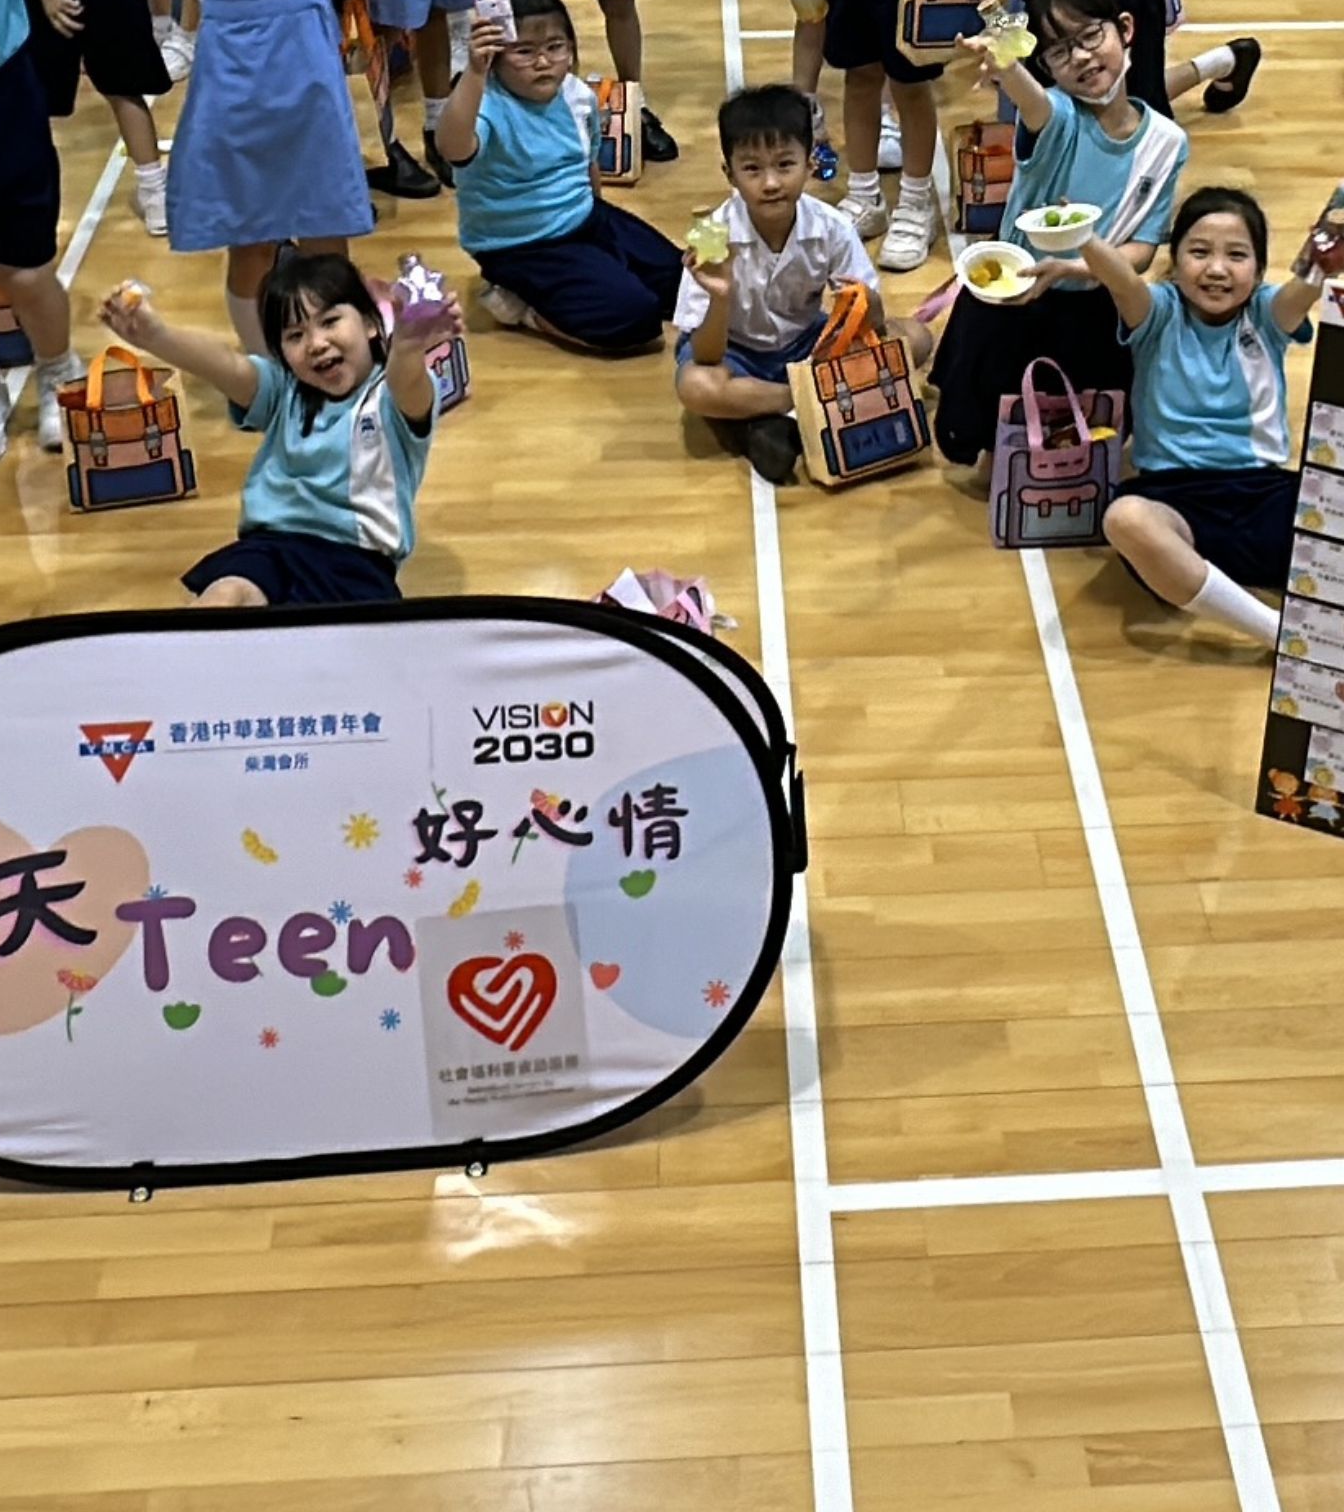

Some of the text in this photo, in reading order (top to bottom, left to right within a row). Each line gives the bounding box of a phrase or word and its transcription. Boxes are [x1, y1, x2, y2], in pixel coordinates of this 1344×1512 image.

[168, 711, 384, 745] 香港中華基督教青年會
[472, 700, 595, 732] VISION
[87, 742, 150, 755] YMCA
[472, 731, 595, 766] 2030
[411, 783, 690, 869] 好心情
